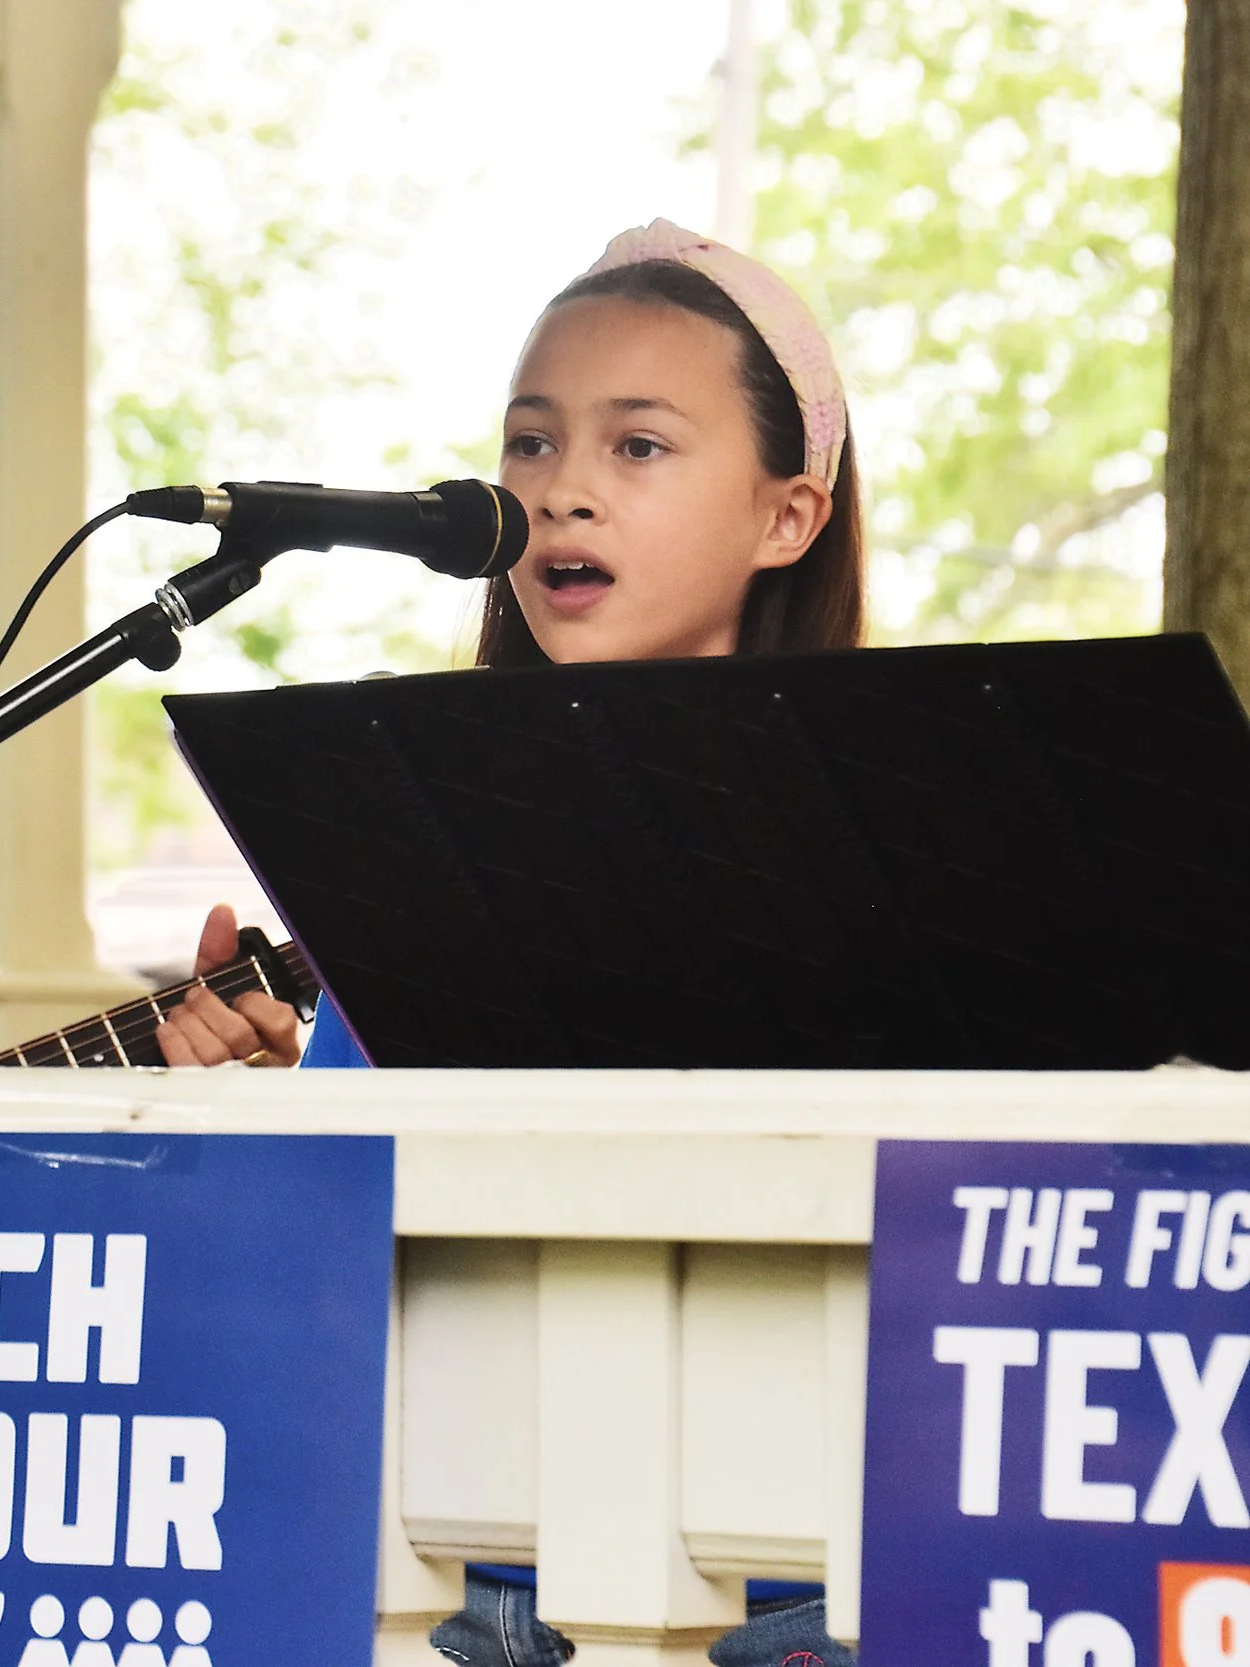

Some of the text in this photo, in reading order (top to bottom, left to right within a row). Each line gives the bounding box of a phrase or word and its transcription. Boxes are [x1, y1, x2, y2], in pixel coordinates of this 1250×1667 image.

[952, 1185, 1250, 1293] THE FIG
[931, 1324, 1250, 1530] TEX
